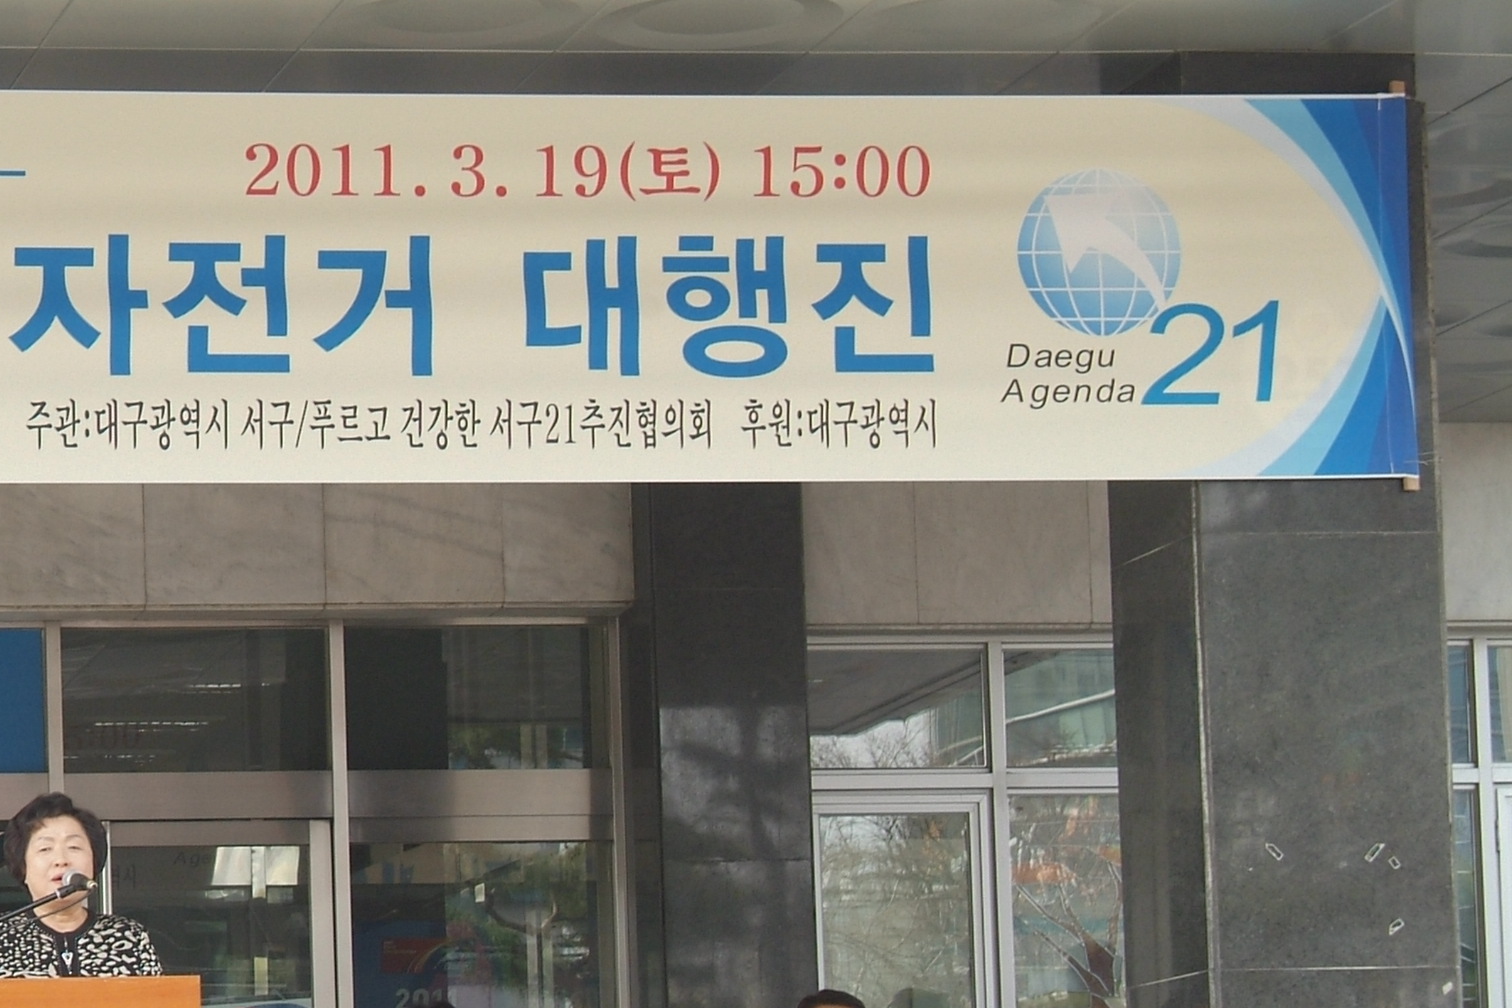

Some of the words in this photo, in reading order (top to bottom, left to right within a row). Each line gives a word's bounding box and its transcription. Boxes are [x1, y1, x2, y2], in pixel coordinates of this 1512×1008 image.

[754, 145, 931, 197] 15:00
[523, 235, 936, 379] 대행진
[1000, 378, 1136, 410] Agenda
[1141, 299, 1279, 406] 21
[1006, 343, 1116, 374] Daegu
[26, 399, 229, 451] 주관:대구광역시
[241, 400, 391, 450] 서구/푸르고
[400, 400, 481, 450] 건강한
[490, 400, 712, 450] 서구21추진협의회
[741, 398, 937, 450] 후원:대구광역시
